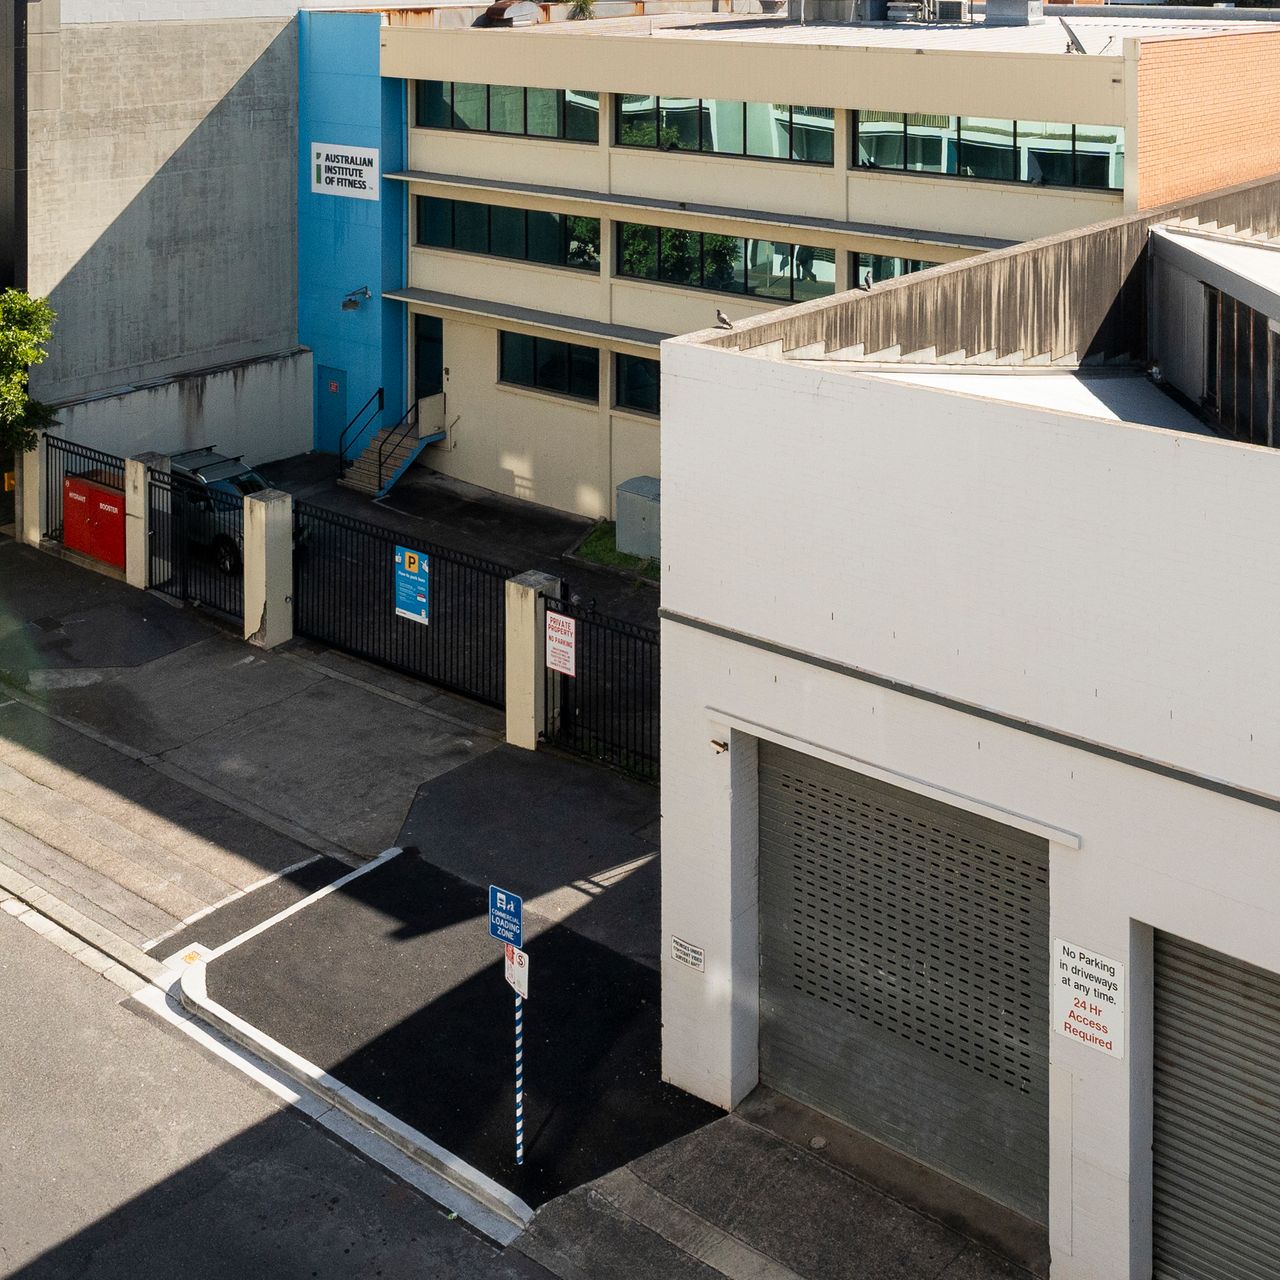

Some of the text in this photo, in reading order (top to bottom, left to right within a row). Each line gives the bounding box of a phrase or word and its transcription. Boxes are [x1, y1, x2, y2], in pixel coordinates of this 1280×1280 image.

[324, 153, 374, 168] AUSTRALIAN
[324, 164, 364, 179] INSTITUTE
[324, 176, 367, 190] OF FITNESS
[99, 502, 119, 514] BOOSTER
[408, 555, 416, 569] P
[548, 623, 573, 638] PROPERTY
[550, 616, 572, 631] PRIVATE
[554, 636, 573, 648] PARKING
[491, 908, 520, 925] COMMERCIAL
[491, 915, 520, 934] LOADING
[497, 926, 515, 940] ZONE
[691, 954, 703, 964] VIDEO
[1062, 945, 1115, 977] No Parking
[1059, 958, 1118, 991] in driveways
[1061, 976, 1117, 1005] at any time.
[1073, 997, 1103, 1017] 24 Hr
[1068, 1010, 1109, 1034] Access
[1064, 1021, 1113, 1051] Required
